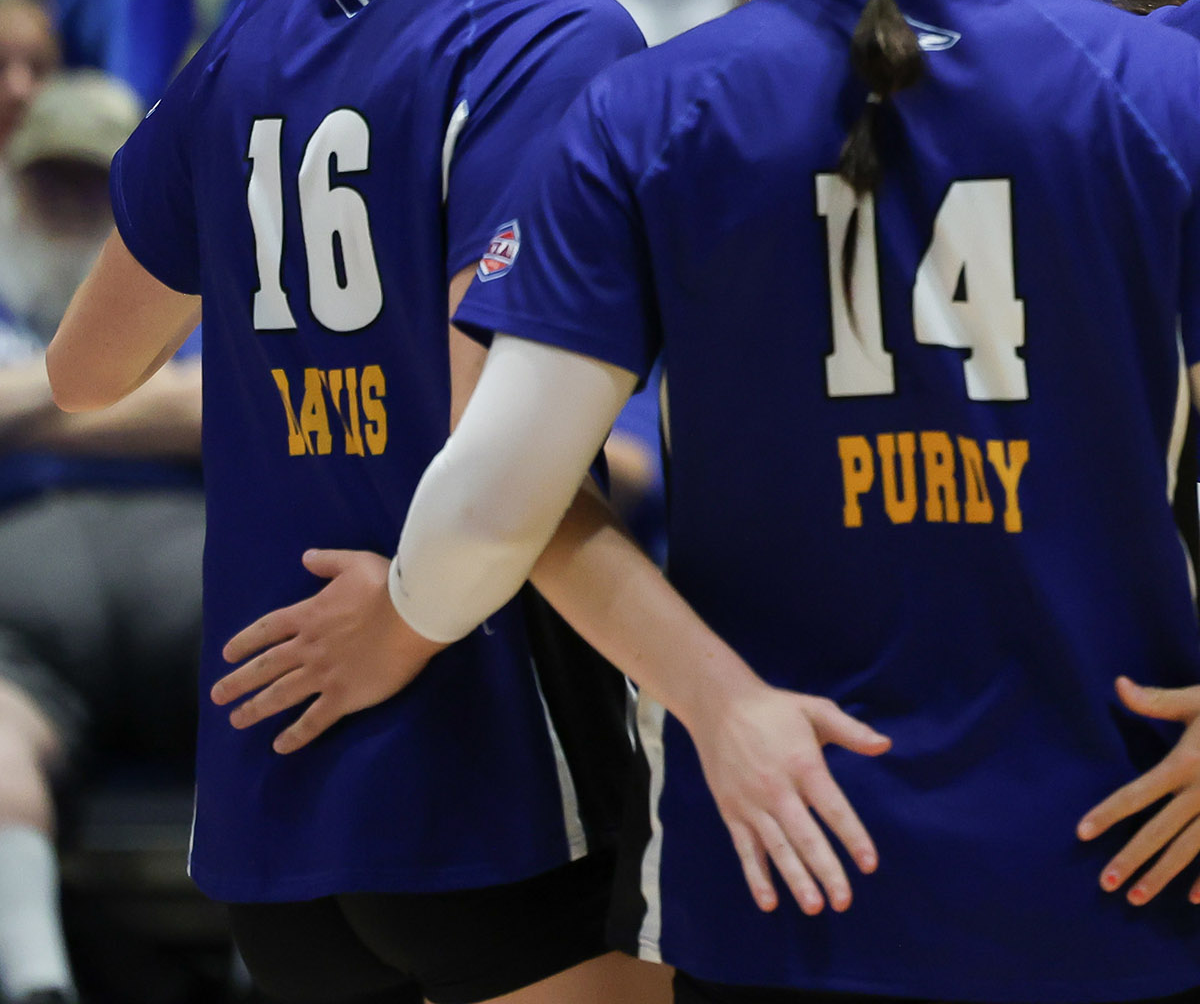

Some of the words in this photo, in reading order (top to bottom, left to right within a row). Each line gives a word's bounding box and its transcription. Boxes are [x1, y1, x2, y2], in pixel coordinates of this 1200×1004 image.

[247, 107, 384, 333] 16
[814, 172, 1030, 402] 14
[837, 431, 1030, 534] PURDY
